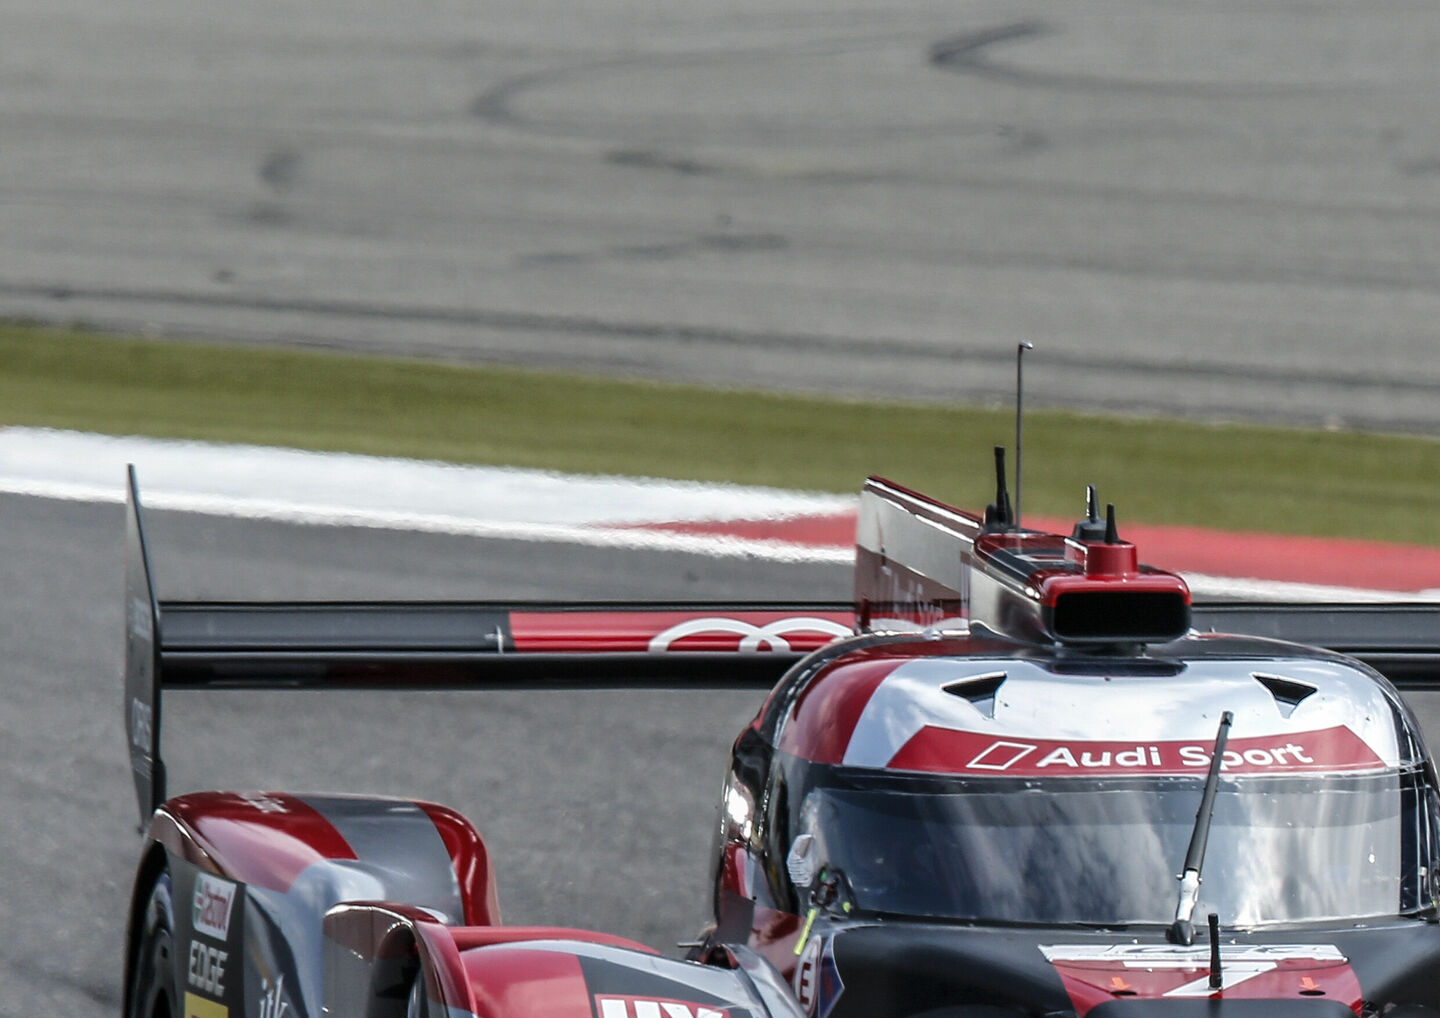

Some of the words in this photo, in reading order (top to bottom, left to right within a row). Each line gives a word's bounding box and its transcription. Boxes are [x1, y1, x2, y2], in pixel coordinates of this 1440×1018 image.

[1036, 746, 1161, 768] Audi
[1181, 743, 1314, 771] Sport
[187, 939, 229, 999] EDGE
[1122, 960, 1278, 998] 7
